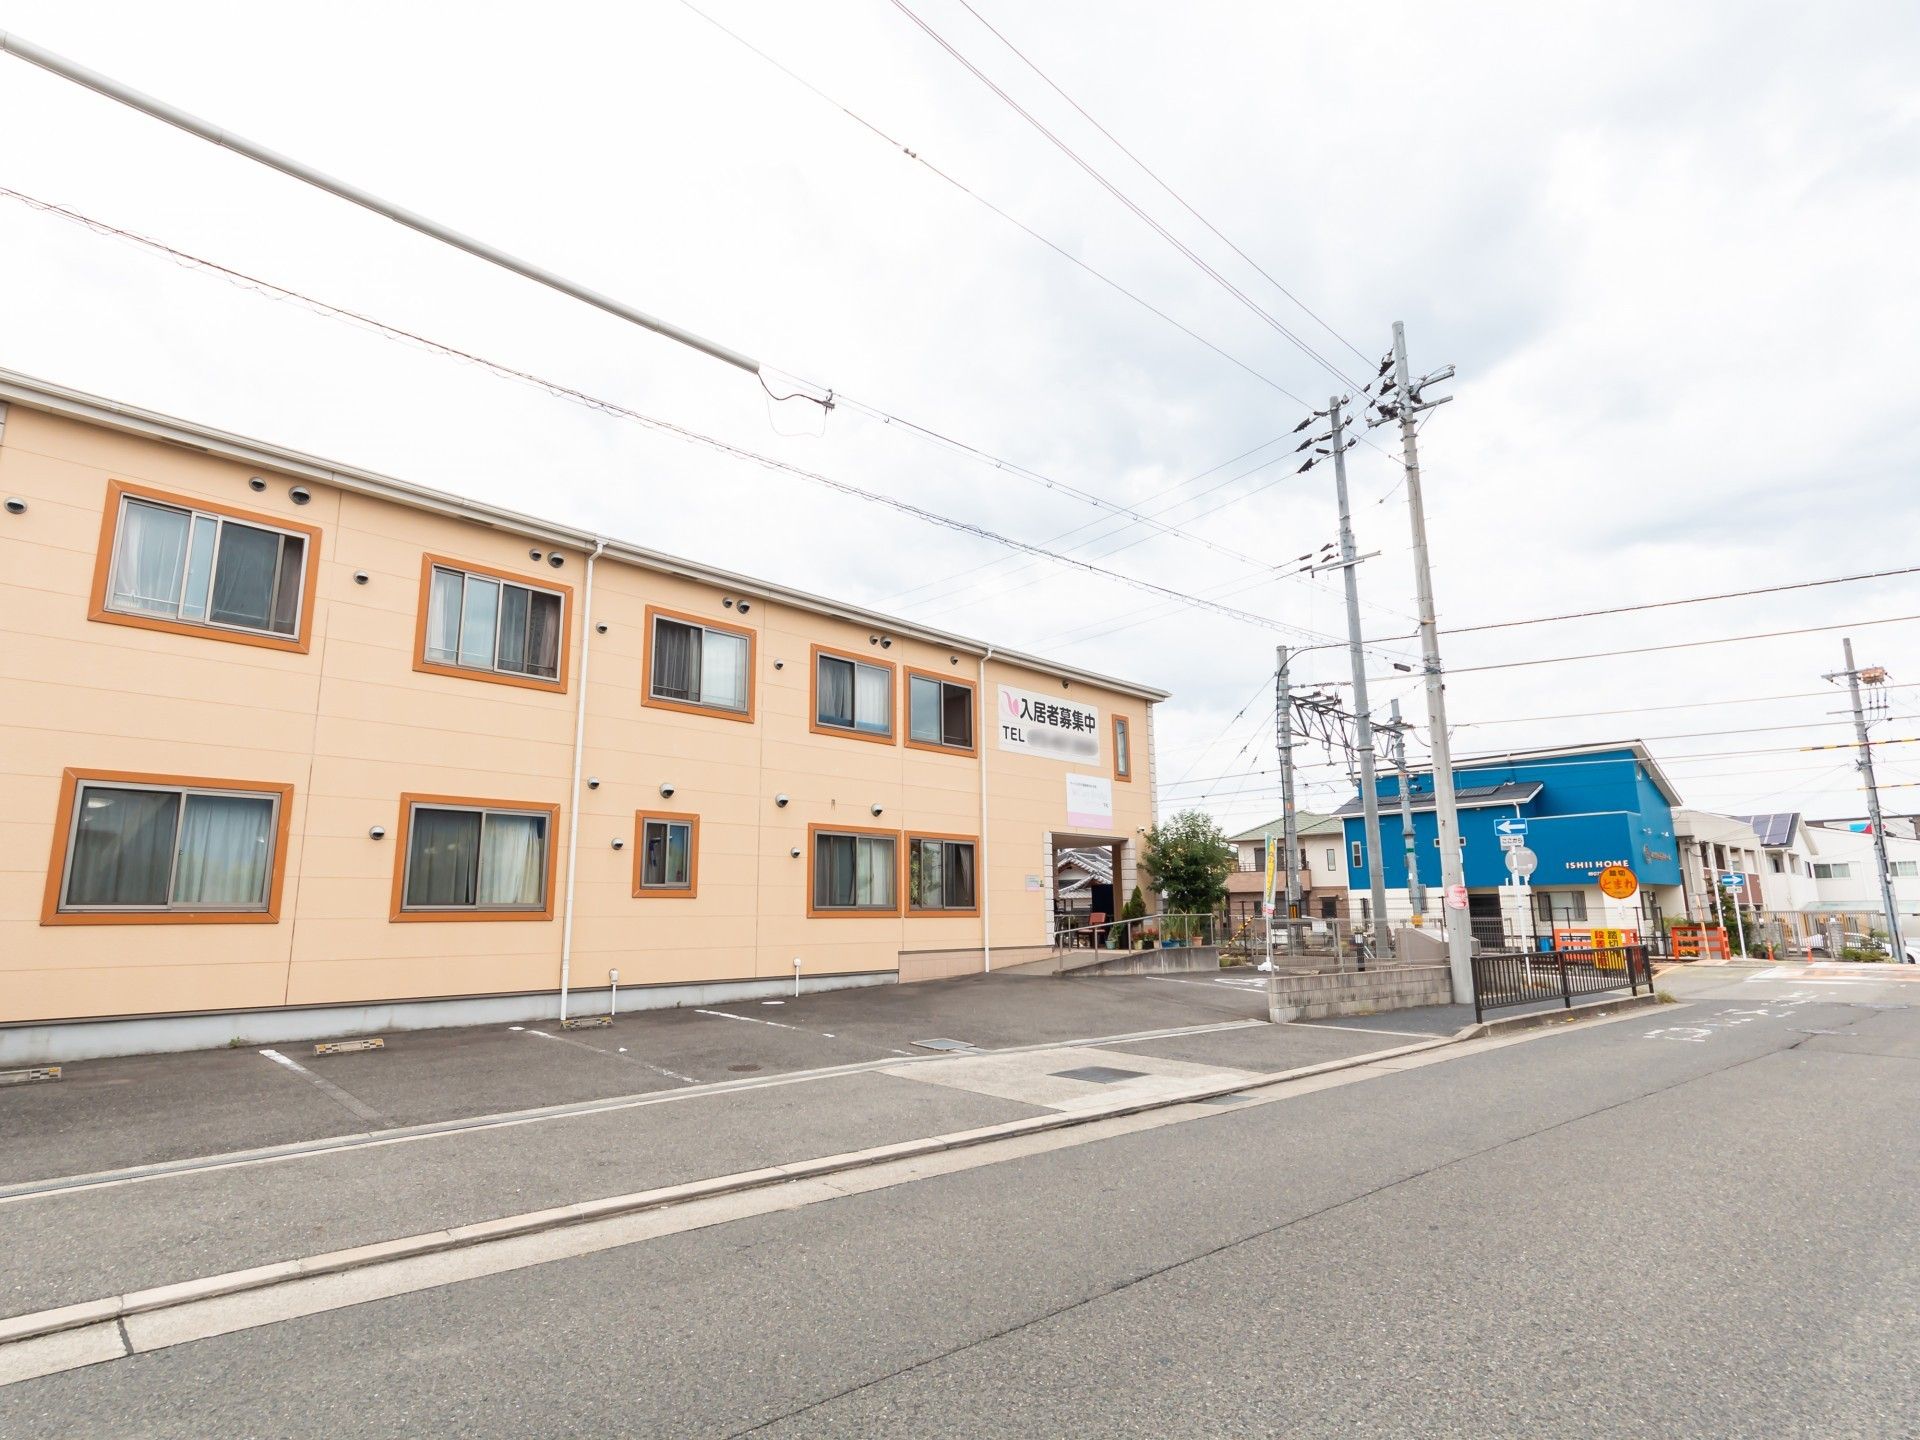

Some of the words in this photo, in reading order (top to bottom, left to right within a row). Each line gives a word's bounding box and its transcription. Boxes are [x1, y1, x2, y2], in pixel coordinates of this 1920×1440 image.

[1020, 698, 1096, 734] 入居者募集中
[1002, 725, 1025, 742] TEL
[1565, 861, 1593, 869] ISHII
[1595, 860, 1630, 868] HOME
[1602, 879, 1635, 890] とまれ
